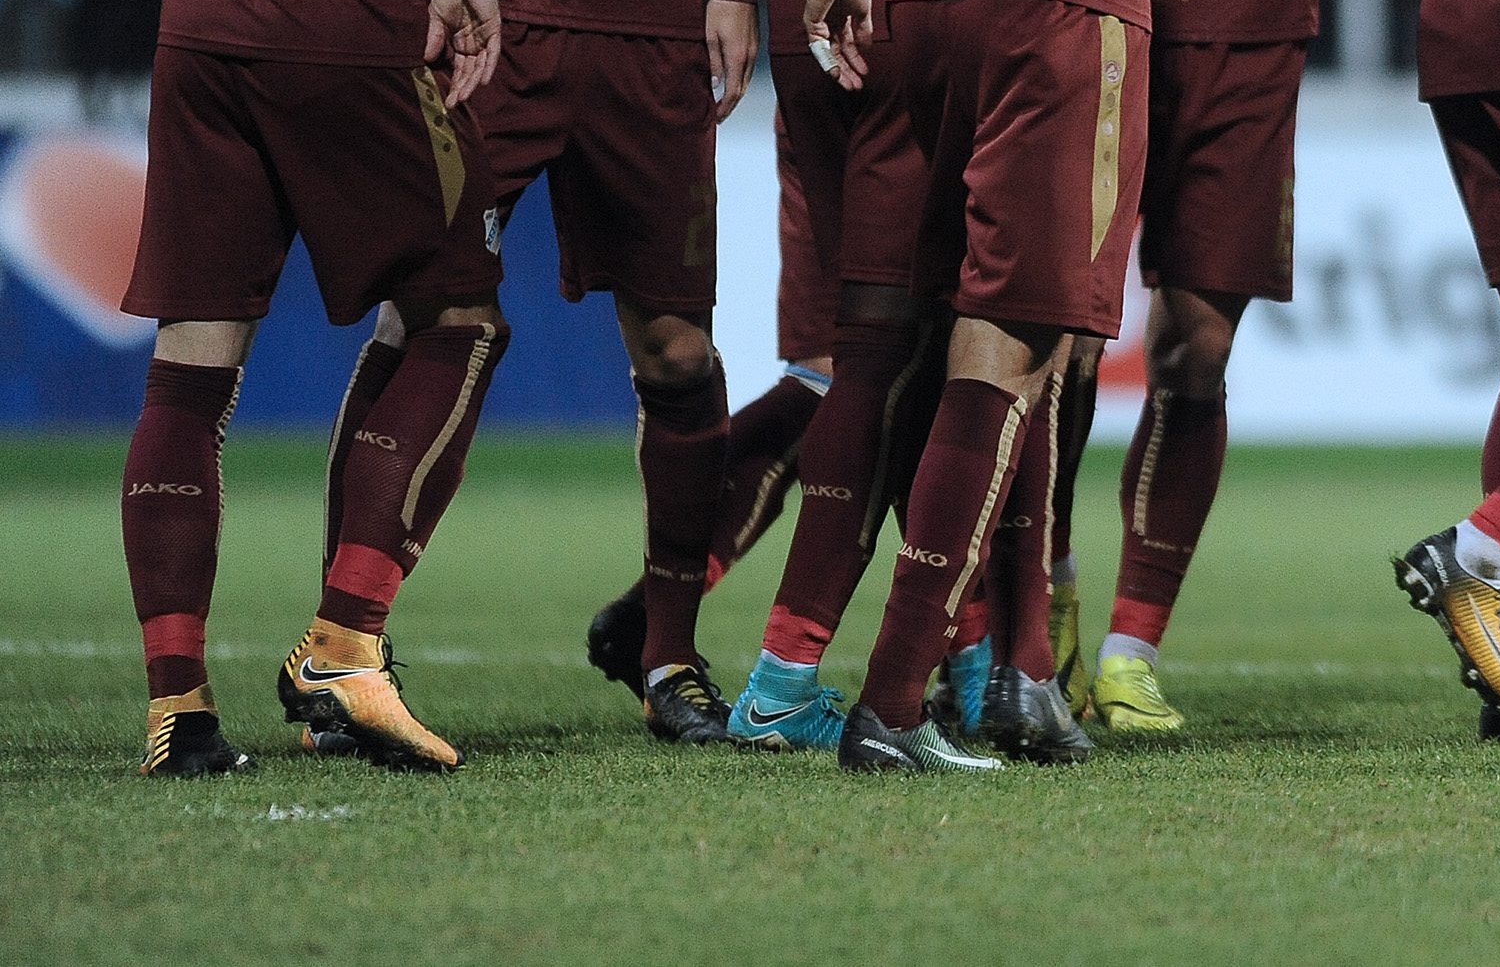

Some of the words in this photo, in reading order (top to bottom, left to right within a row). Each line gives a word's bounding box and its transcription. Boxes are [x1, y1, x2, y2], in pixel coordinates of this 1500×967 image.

[354, 430, 398, 451] AKO
[127, 482, 203, 497] JAKO
[899, 542, 949, 568] JAKO
